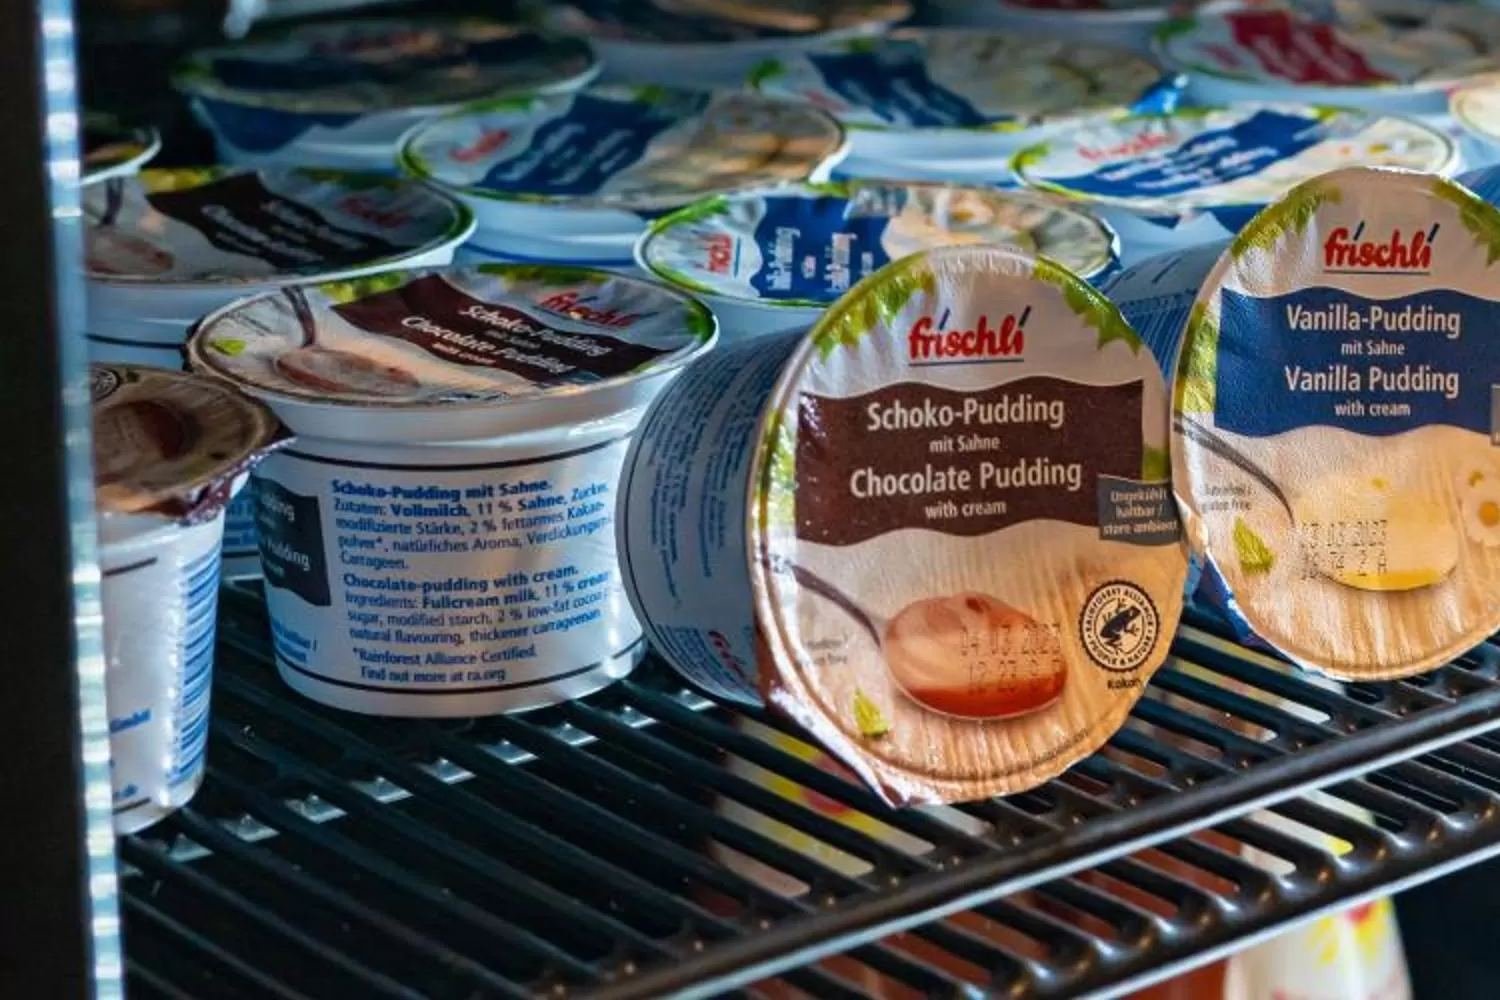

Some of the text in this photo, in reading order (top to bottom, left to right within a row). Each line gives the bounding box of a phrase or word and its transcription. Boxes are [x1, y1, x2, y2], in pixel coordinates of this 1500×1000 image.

[1286, 304, 1462, 340] Vanilla-Pudding
[1340, 340, 1405, 356] mit Sahne
[1285, 365, 1460, 399] Vanilla Pudding
[867, 395, 1066, 431] Schoko-Pudding
[1334, 401, 1411, 417] with cream
[929, 434, 1000, 452] mit Sahne
[850, 460, 1082, 498] Chocolate Pudding
[331, 479, 461, 502] Schoko-Pudding
[465, 485, 494, 499] mit
[925, 502, 1007, 519] with cream
[493, 571, 529, 590] with
